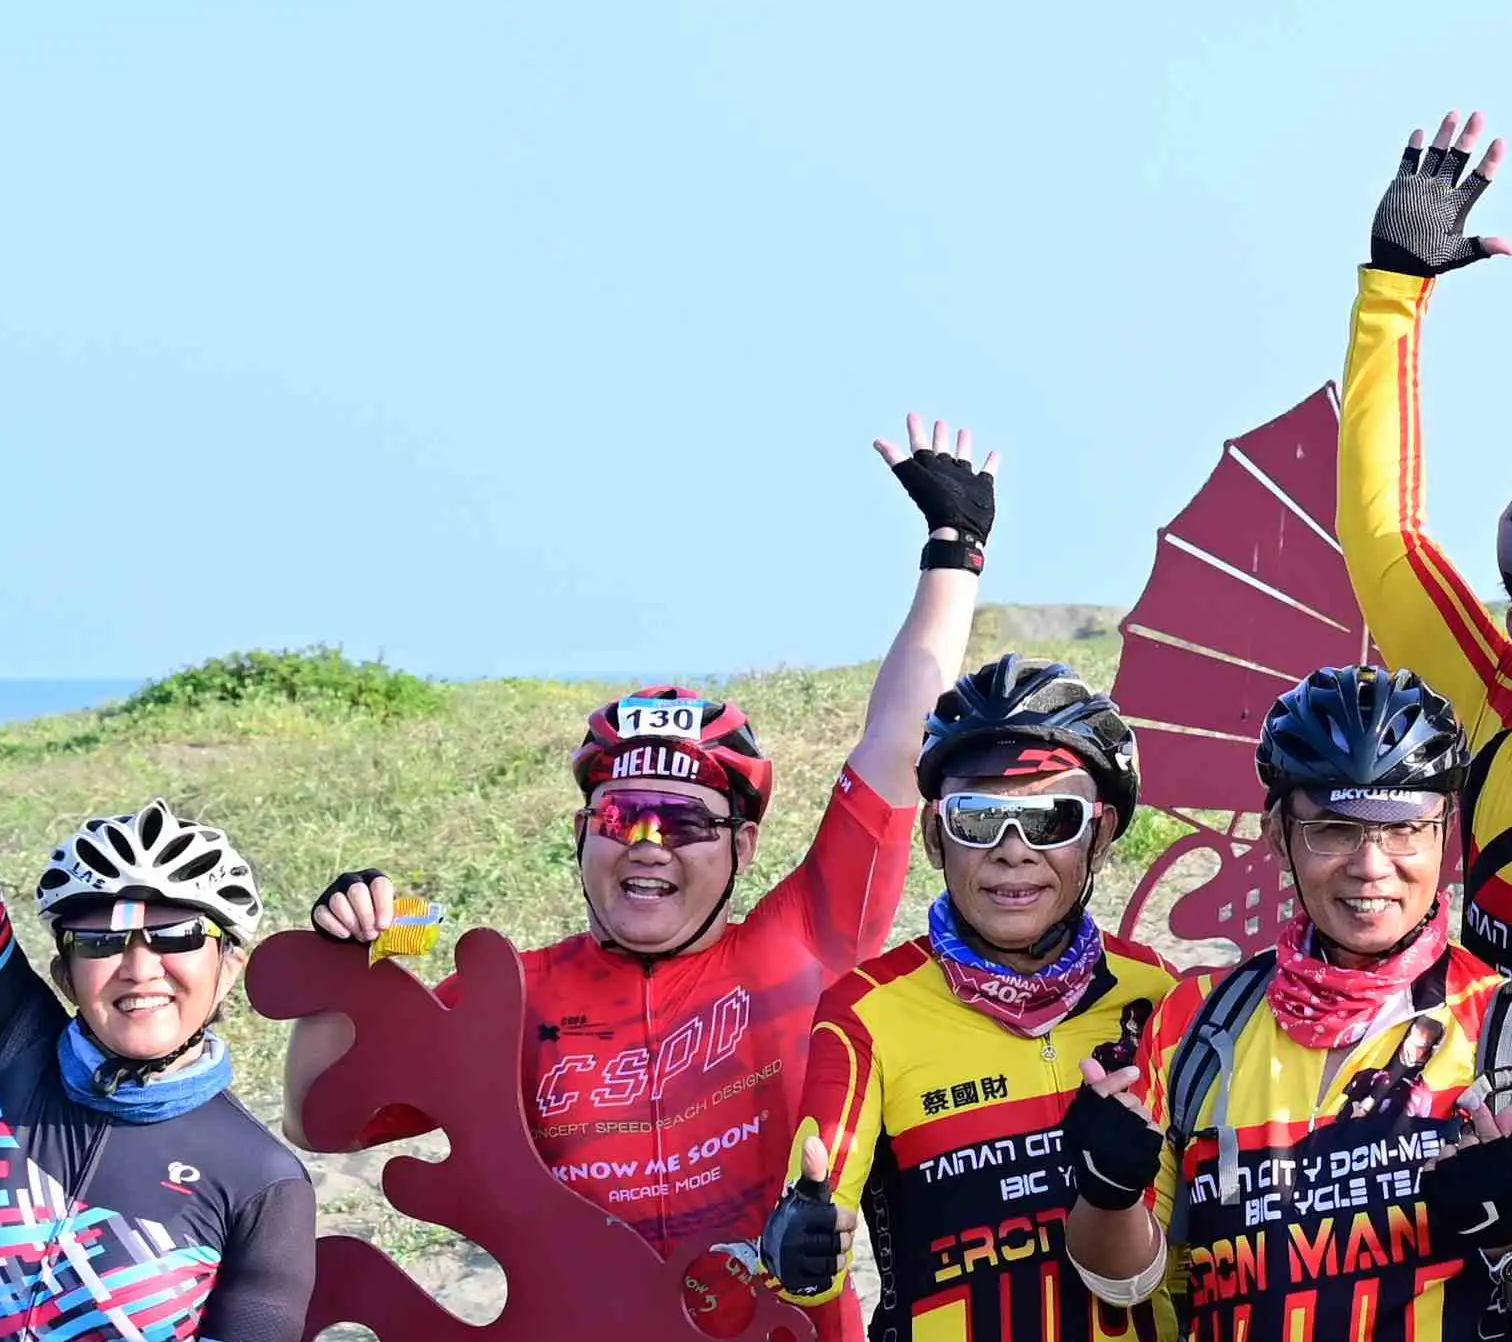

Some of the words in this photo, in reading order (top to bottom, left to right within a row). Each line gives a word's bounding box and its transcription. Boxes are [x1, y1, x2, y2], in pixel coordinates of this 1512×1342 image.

[626, 708, 694, 732] 130
[611, 745, 700, 780] HELLO!
[536, 985, 750, 1118] CSPD
[530, 1122, 590, 1141] ONCEPT
[594, 1121, 652, 1134] SPEED
[711, 1057, 783, 1105] DESIGNED
[920, 1074, 1008, 1117] 蔡國財
[551, 1159, 639, 1183] KNOW
[643, 1152, 681, 1177] ME
[919, 1137, 1017, 1184] TAINAN
[1024, 1129, 1065, 1158] CIT
[1257, 1154, 1322, 1189] CITY
[1329, 1129, 1446, 1180] DON-ME
[608, 1182, 670, 1204] ARCADE
[675, 1165, 722, 1195] MODE
[1288, 1200, 1432, 1284] MAN
